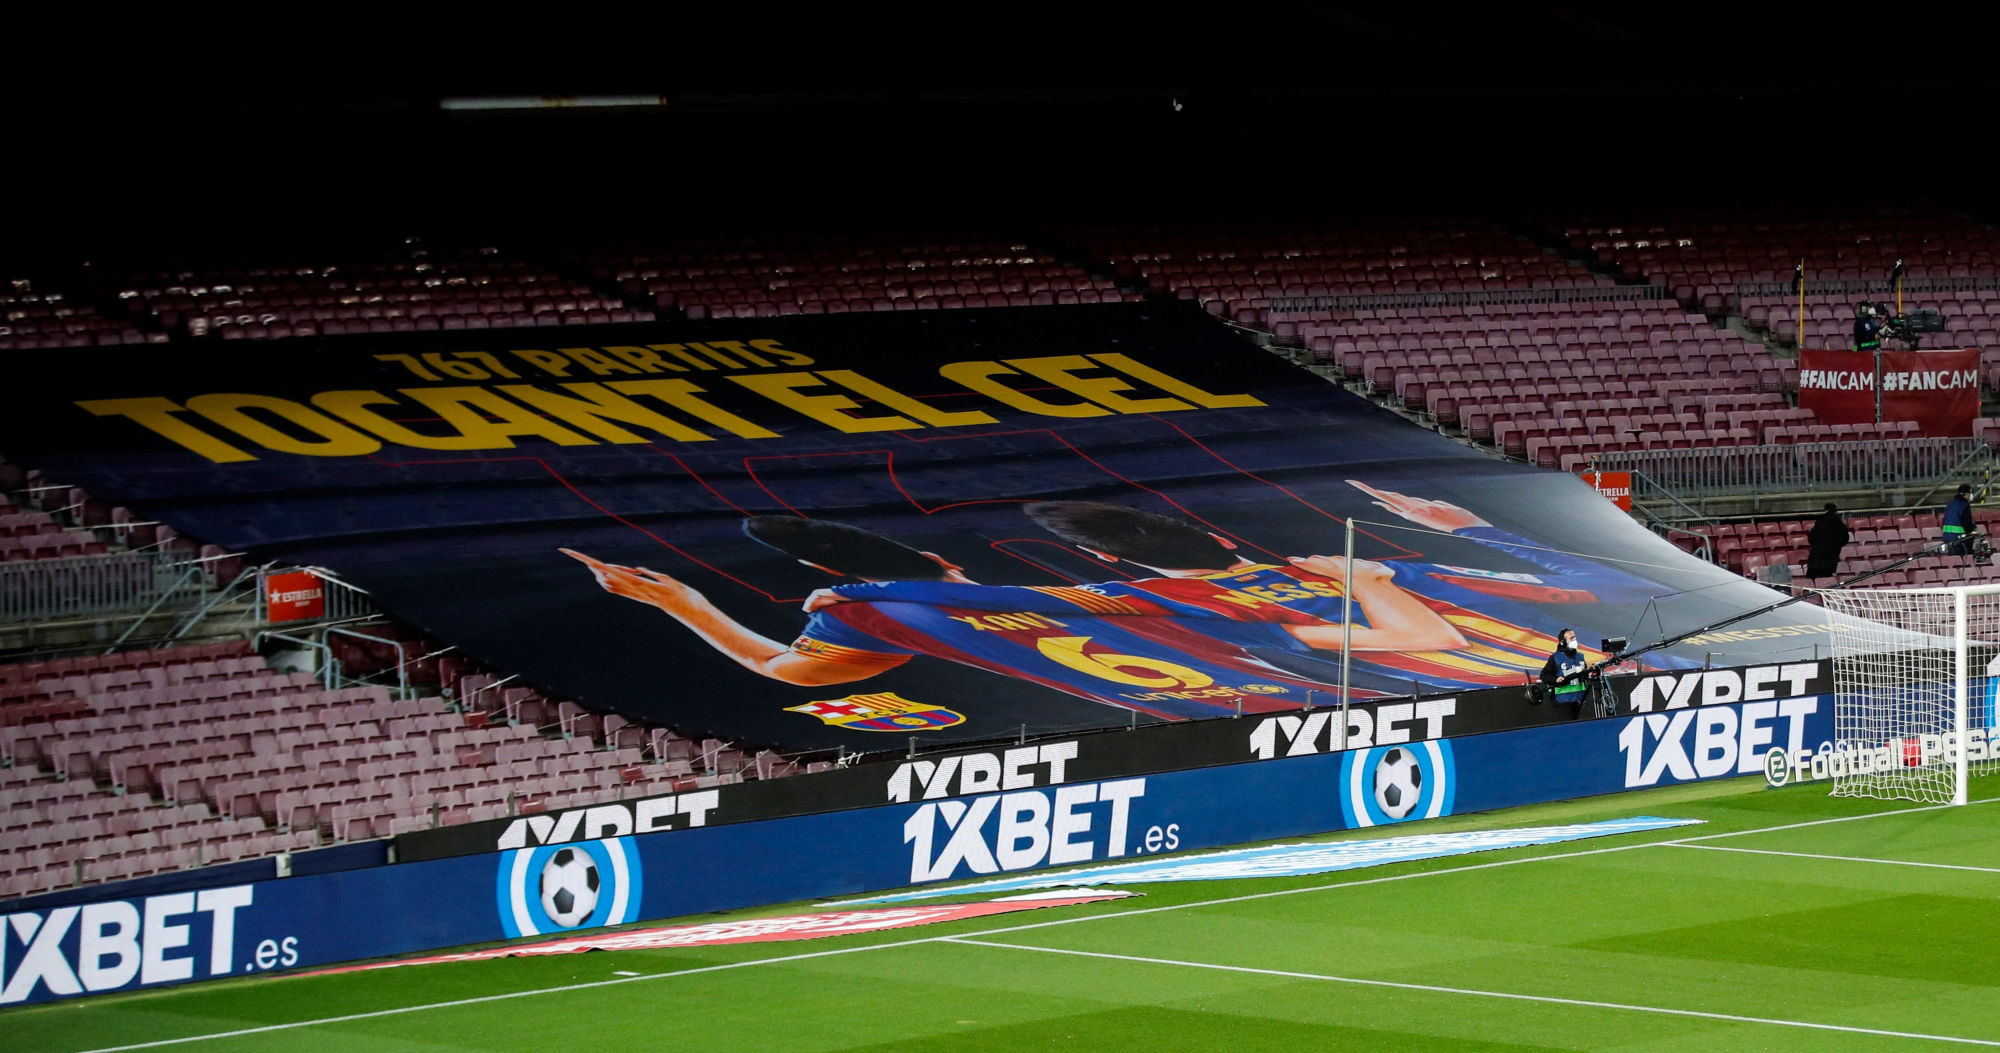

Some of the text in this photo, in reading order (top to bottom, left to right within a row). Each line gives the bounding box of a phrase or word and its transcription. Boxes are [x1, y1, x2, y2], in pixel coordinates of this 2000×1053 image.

[371, 339, 816, 382] 767 PARTITS
[1800, 369, 1873, 391] #FANCAM
[1883, 370, 1977, 391] #FANCAM
[73, 353, 1269, 464] TOCANT EL CEL
[1599, 487, 1630, 497] STRELLA
[948, 612, 1068, 631] XAVI
[1037, 636, 1214, 689] 6
[1119, 686, 1248, 702] unicef
[1630, 663, 1818, 713] 1XBET
[1250, 698, 1456, 760] 1XBET
[887, 741, 1078, 803] 1XBET
[0, 885, 299, 1004] XBET.es
